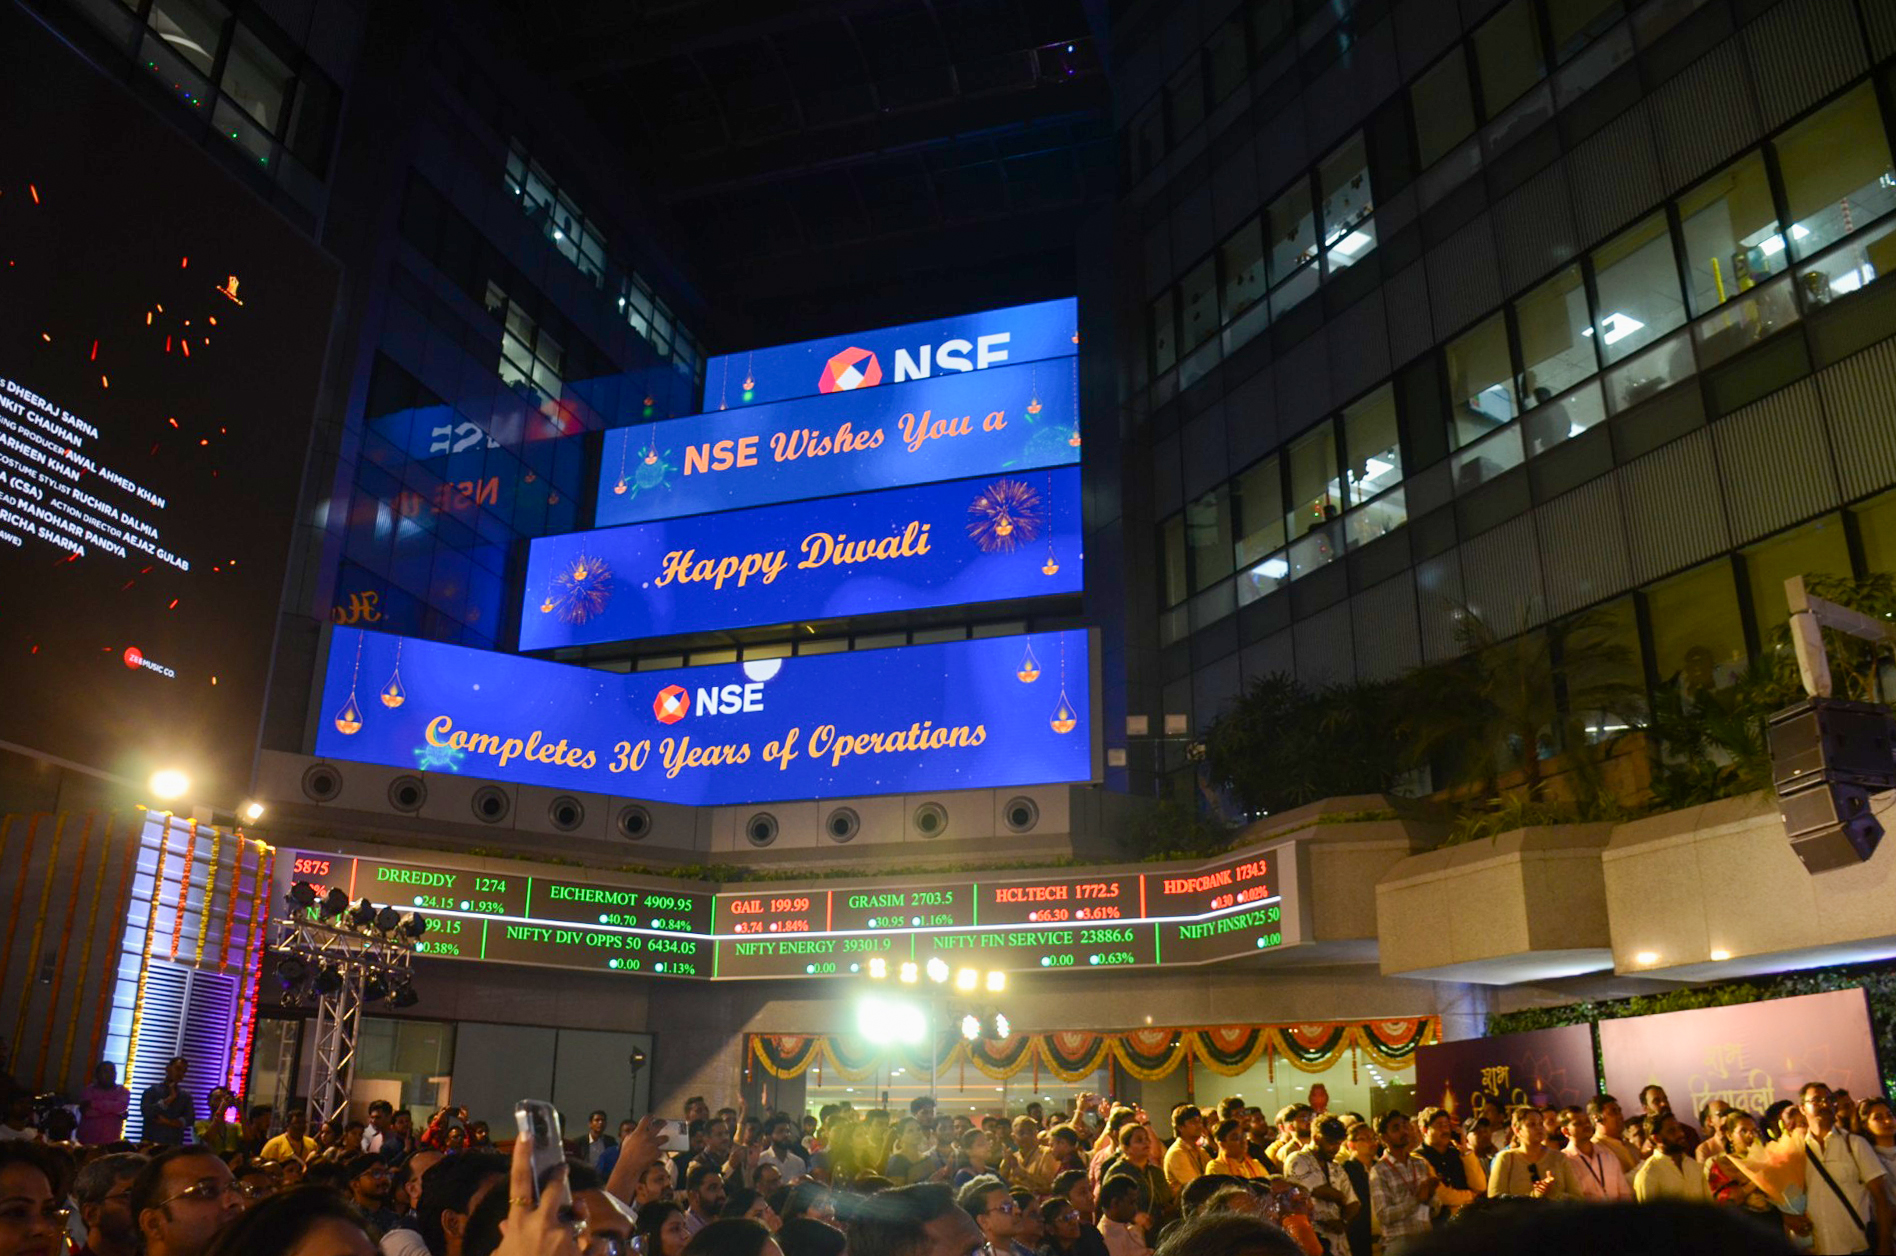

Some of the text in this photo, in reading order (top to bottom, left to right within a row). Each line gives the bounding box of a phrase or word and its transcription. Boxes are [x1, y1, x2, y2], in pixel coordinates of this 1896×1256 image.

[0, 394, 82, 447] NKIT CHAUHAN
[6, 381, 60, 417] DHEERAJ
[61, 411, 98, 439] SARNA
[683, 409, 1007, 476] NSE Wishes You a
[0, 432, 80, 482] ARHEEN KHAN
[0, 415, 165, 509] ING PRODUCER AWAL AHMED KHAN
[38, 473, 71, 495] STYLIST
[72, 488, 119, 519] RUCHIRA
[121, 513, 158, 540] DALMIA
[0, 508, 86, 557] RICHA SHARMA
[10, 477, 43, 500] (CSA)
[50, 499, 82, 519] ACTION
[83, 513, 122, 538] DIRECTOR
[122, 532, 156, 555] AEJAZ
[156, 549, 189, 571] GULAB
[17, 499, 84, 538] MANOHARR
[85, 530, 126, 559] PANDYA
[654, 520, 931, 590] Happy Diwali
[695, 683, 764, 716] NSE
[425, 715, 987, 779] Completes 30 Years of Operations
[293, 859, 330, 876] 5875
[377, 867, 506, 893] DRREDDY 1274
[1163, 860, 1267, 894] HDFCBANK 1734.3
[422, 895, 504, 914] 24.15 1.93%
[550, 885, 693, 911] EICHERMOT 4909.95
[848, 891, 953, 909] GRASIM 2703.5
[996, 883, 1120, 902] HCLTECH 1772.5
[730, 898, 810, 914] GAIL 199.99
[1037, 909, 1069, 922] 66.30
[608, 914, 692, 932] 40.70 0.84%
[741, 920, 809, 934] 3.74 1.84%
[876, 914, 953, 928] 30.95 1.16%
[1178, 906, 1281, 939] NIFTY FINSRV25 50
[423, 942, 460, 956] 0.38%
[506, 925, 697, 955] NIFTY DIV OPPS 50 6434.05
[735, 938, 891, 955] NIFTY ENERGY 39301.9
[933, 928, 1134, 949] NIFTY FIN SERVICE 23886.6
[617, 958, 696, 975] 0.00 1.13%
[814, 963, 836, 973] 0.00
[1050, 952, 1135, 966] 0.00 0.63%
